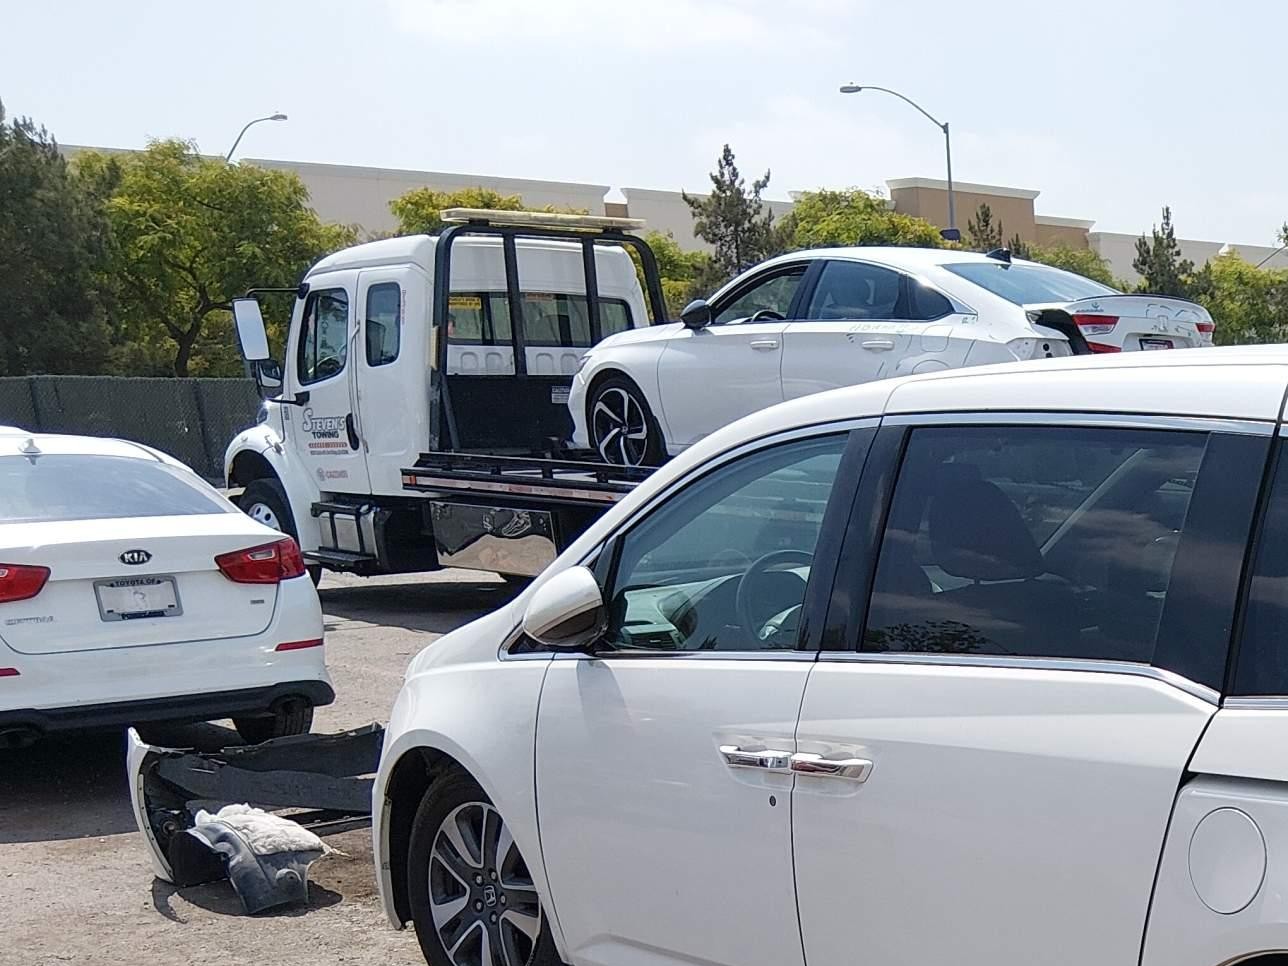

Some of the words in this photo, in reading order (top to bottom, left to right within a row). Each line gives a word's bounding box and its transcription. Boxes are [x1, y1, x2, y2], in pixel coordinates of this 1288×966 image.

[303, 407, 345, 432] STEVEN'S
[312, 430, 339, 439] TOWING
[123, 551, 149, 563] KIA
[115, 578, 146, 587] TOYOTA
